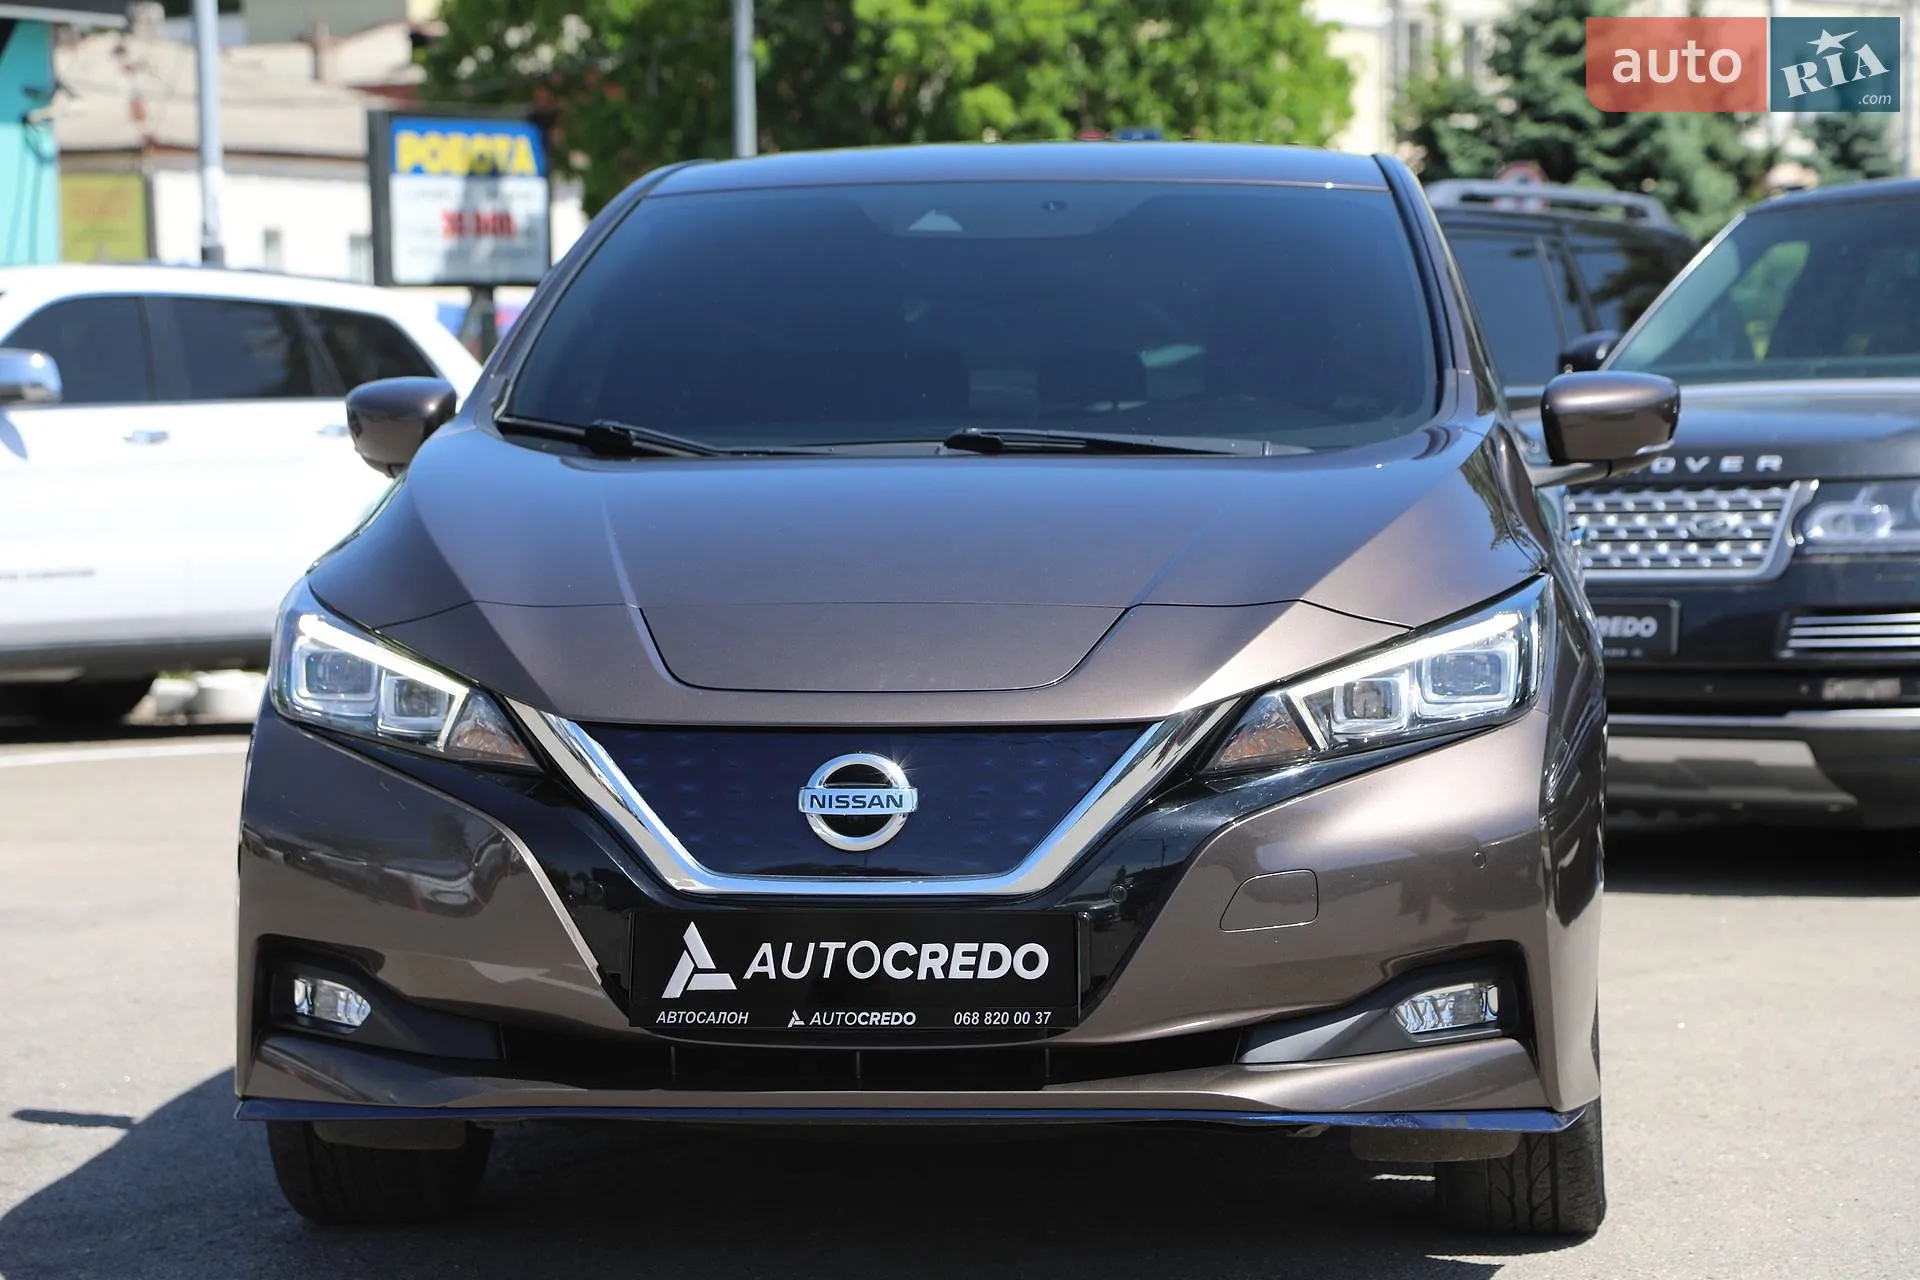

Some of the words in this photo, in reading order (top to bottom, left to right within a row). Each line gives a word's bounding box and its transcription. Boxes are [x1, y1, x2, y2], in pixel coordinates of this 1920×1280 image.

[1633, 454, 1784, 475] OVER
[809, 794, 904, 809] NISSAN
[742, 939, 1050, 981] AUTOCREDO
[655, 1010, 750, 1025] АВТОСАЛОН
[808, 1011, 918, 1026] AUTOCREDO
[953, 1011, 981, 1026] 068
[983, 1011, 1010, 1026] 820
[1013, 1011, 1031, 1026] 00
[1034, 1011, 1053, 1025] 37
